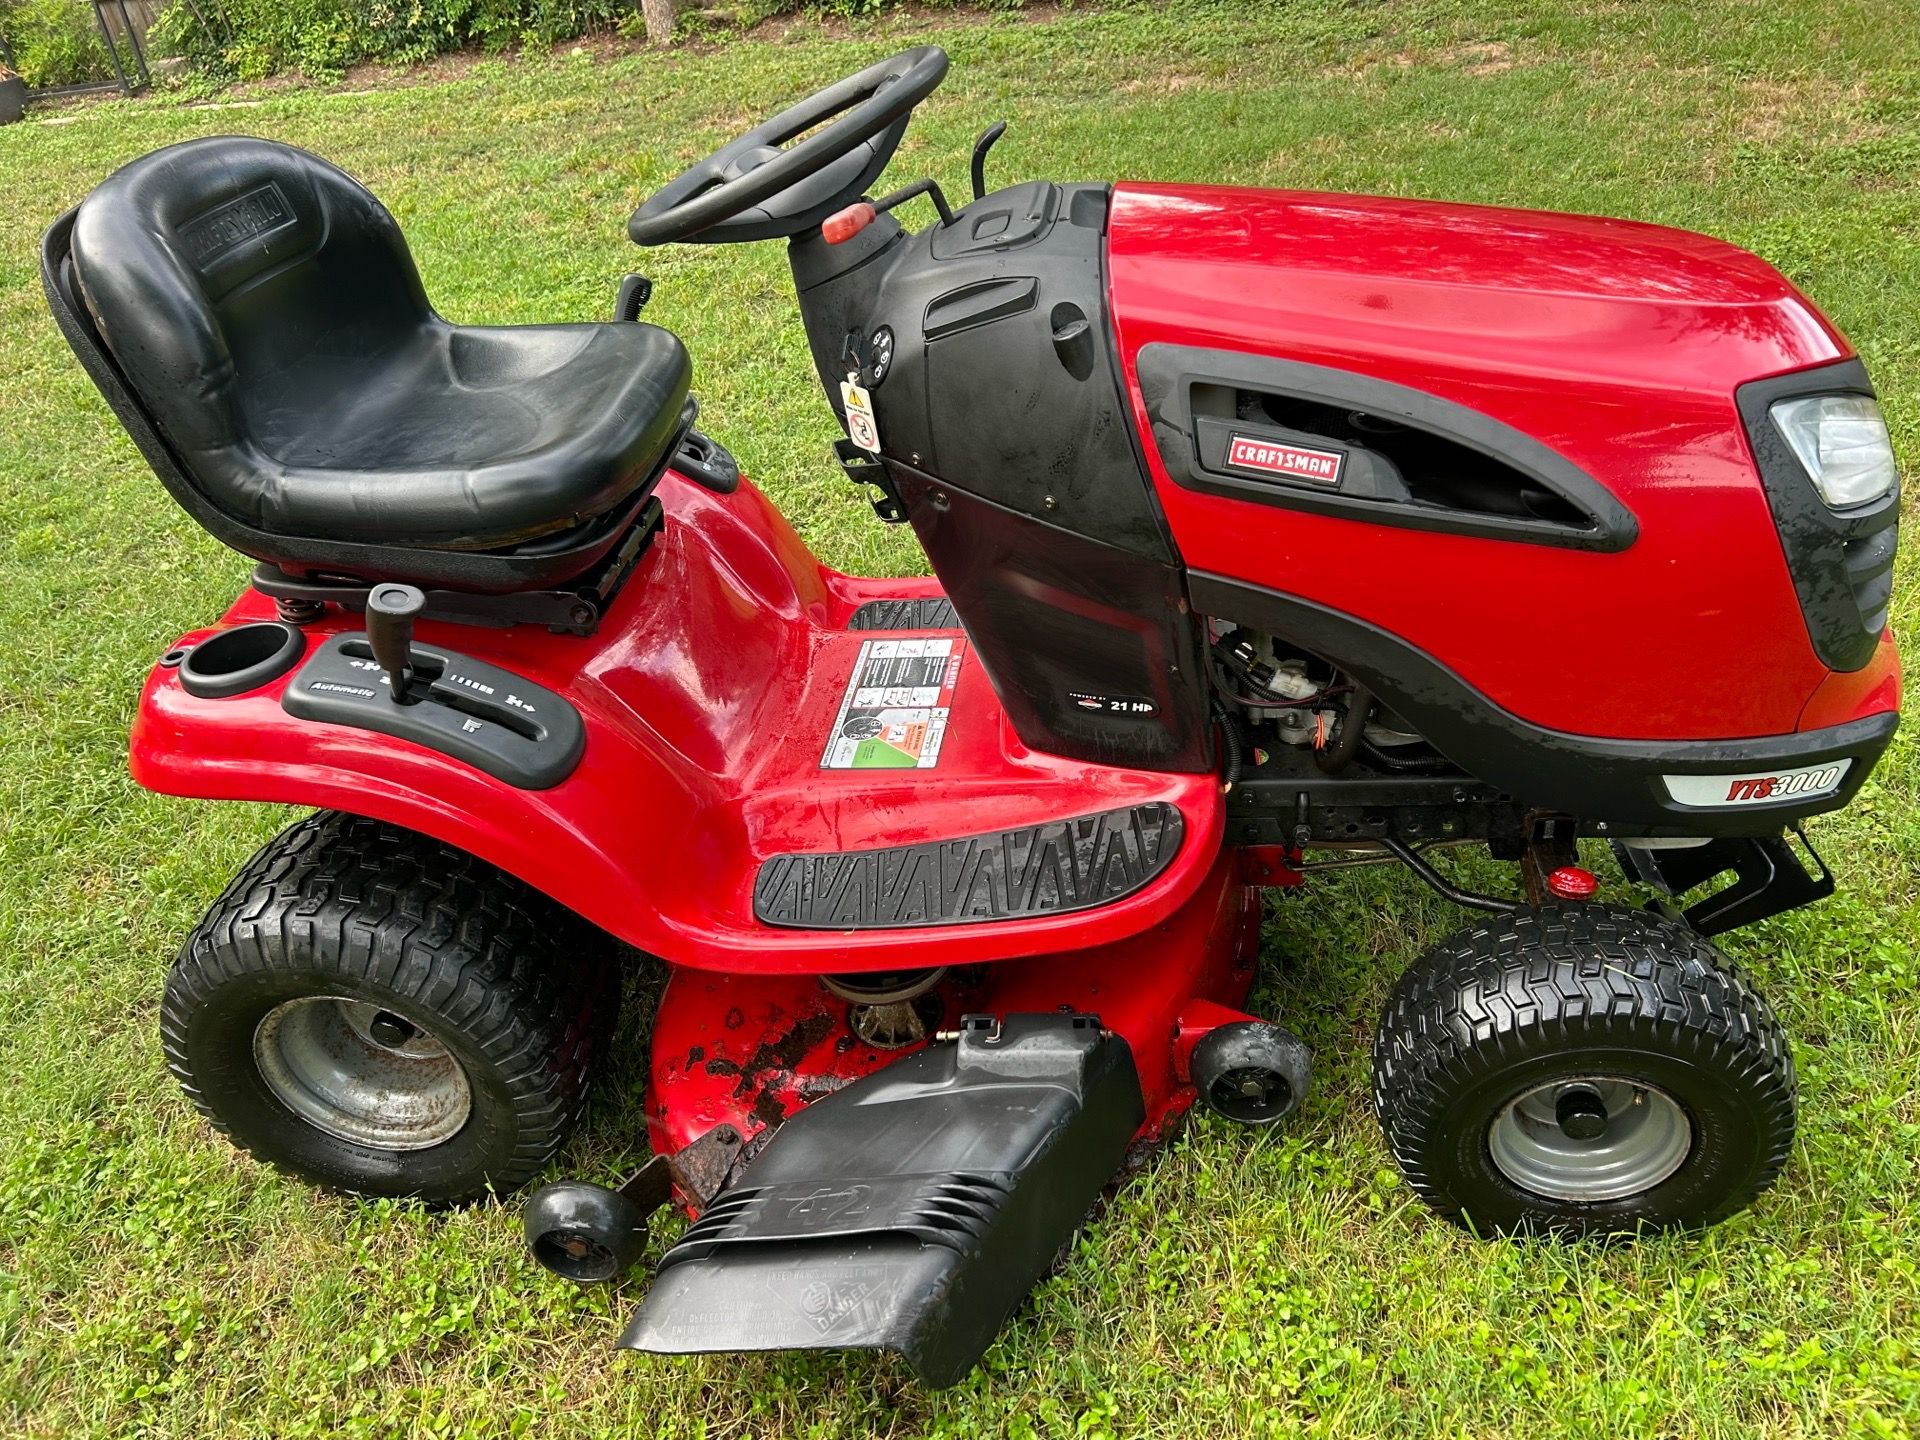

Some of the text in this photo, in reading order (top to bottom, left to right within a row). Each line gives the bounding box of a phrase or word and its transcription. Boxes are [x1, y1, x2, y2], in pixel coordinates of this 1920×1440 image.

[1236, 445, 1331, 474] CRAFTSMAN
[311, 682, 375, 697] Automatic
[1110, 701, 1128, 711] 21
[1131, 702, 1153, 712] HP
[1725, 766, 1840, 801] YTS3000
[817, 1283, 869, 1330] DANGER
